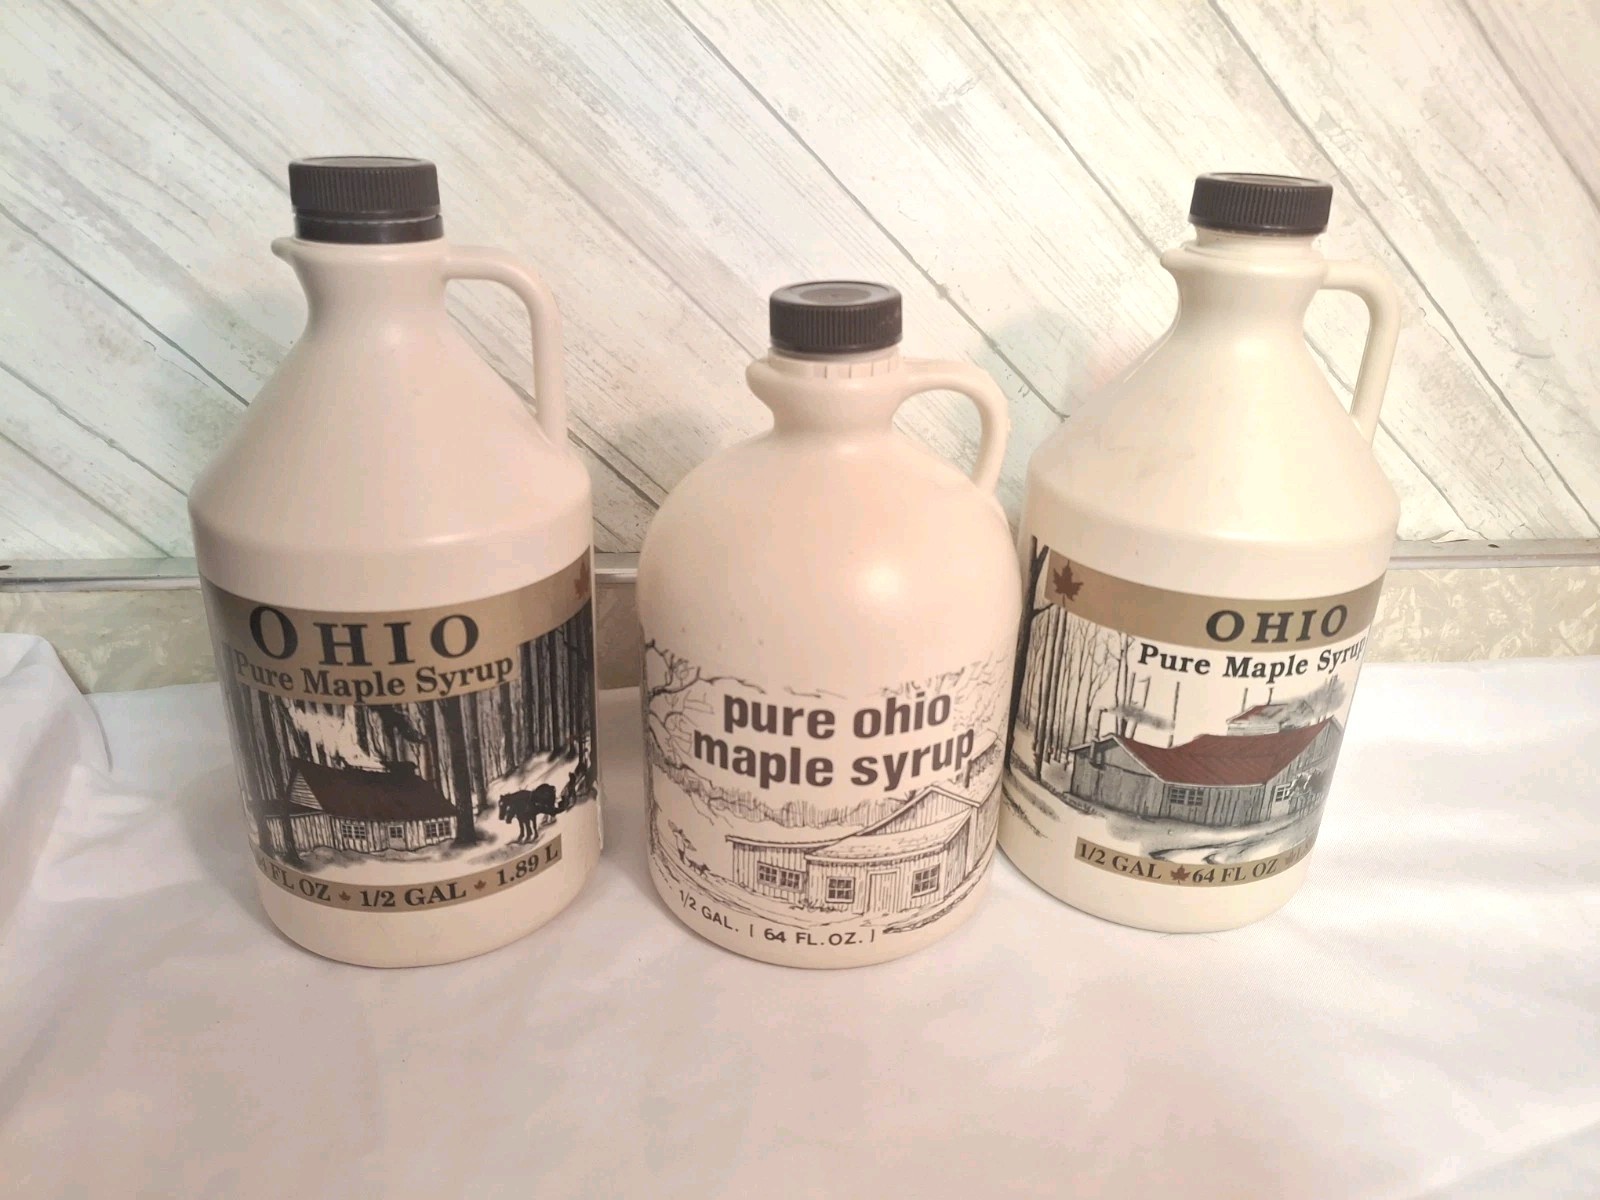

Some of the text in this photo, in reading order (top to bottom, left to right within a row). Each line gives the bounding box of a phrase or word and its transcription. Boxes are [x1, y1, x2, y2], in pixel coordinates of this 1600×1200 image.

[249, 605, 480, 667] OHIO
[1206, 604, 1348, 643] OHIO
[233, 649, 514, 702] Pure Maple Syrup
[1138, 643, 1211, 675] Pure
[1222, 654, 1309, 684] Maple
[723, 691, 952, 740] pure ohio
[693, 729, 975, 791] maple syrup
[270, 862, 295, 890] FL
[299, 878, 331, 901] OZ
[360, 889, 396, 908] 1/2
[404, 882, 467, 907] GAL
[496, 853, 540, 887] 1.89
[544, 844, 560, 865] L
[1079, 842, 1279, 883] 1/2 GAL 64 FL OZ
[680, 889, 697, 911] 1/2
[701, 905, 739, 932] GAL.
[764, 928, 787, 943] 64
